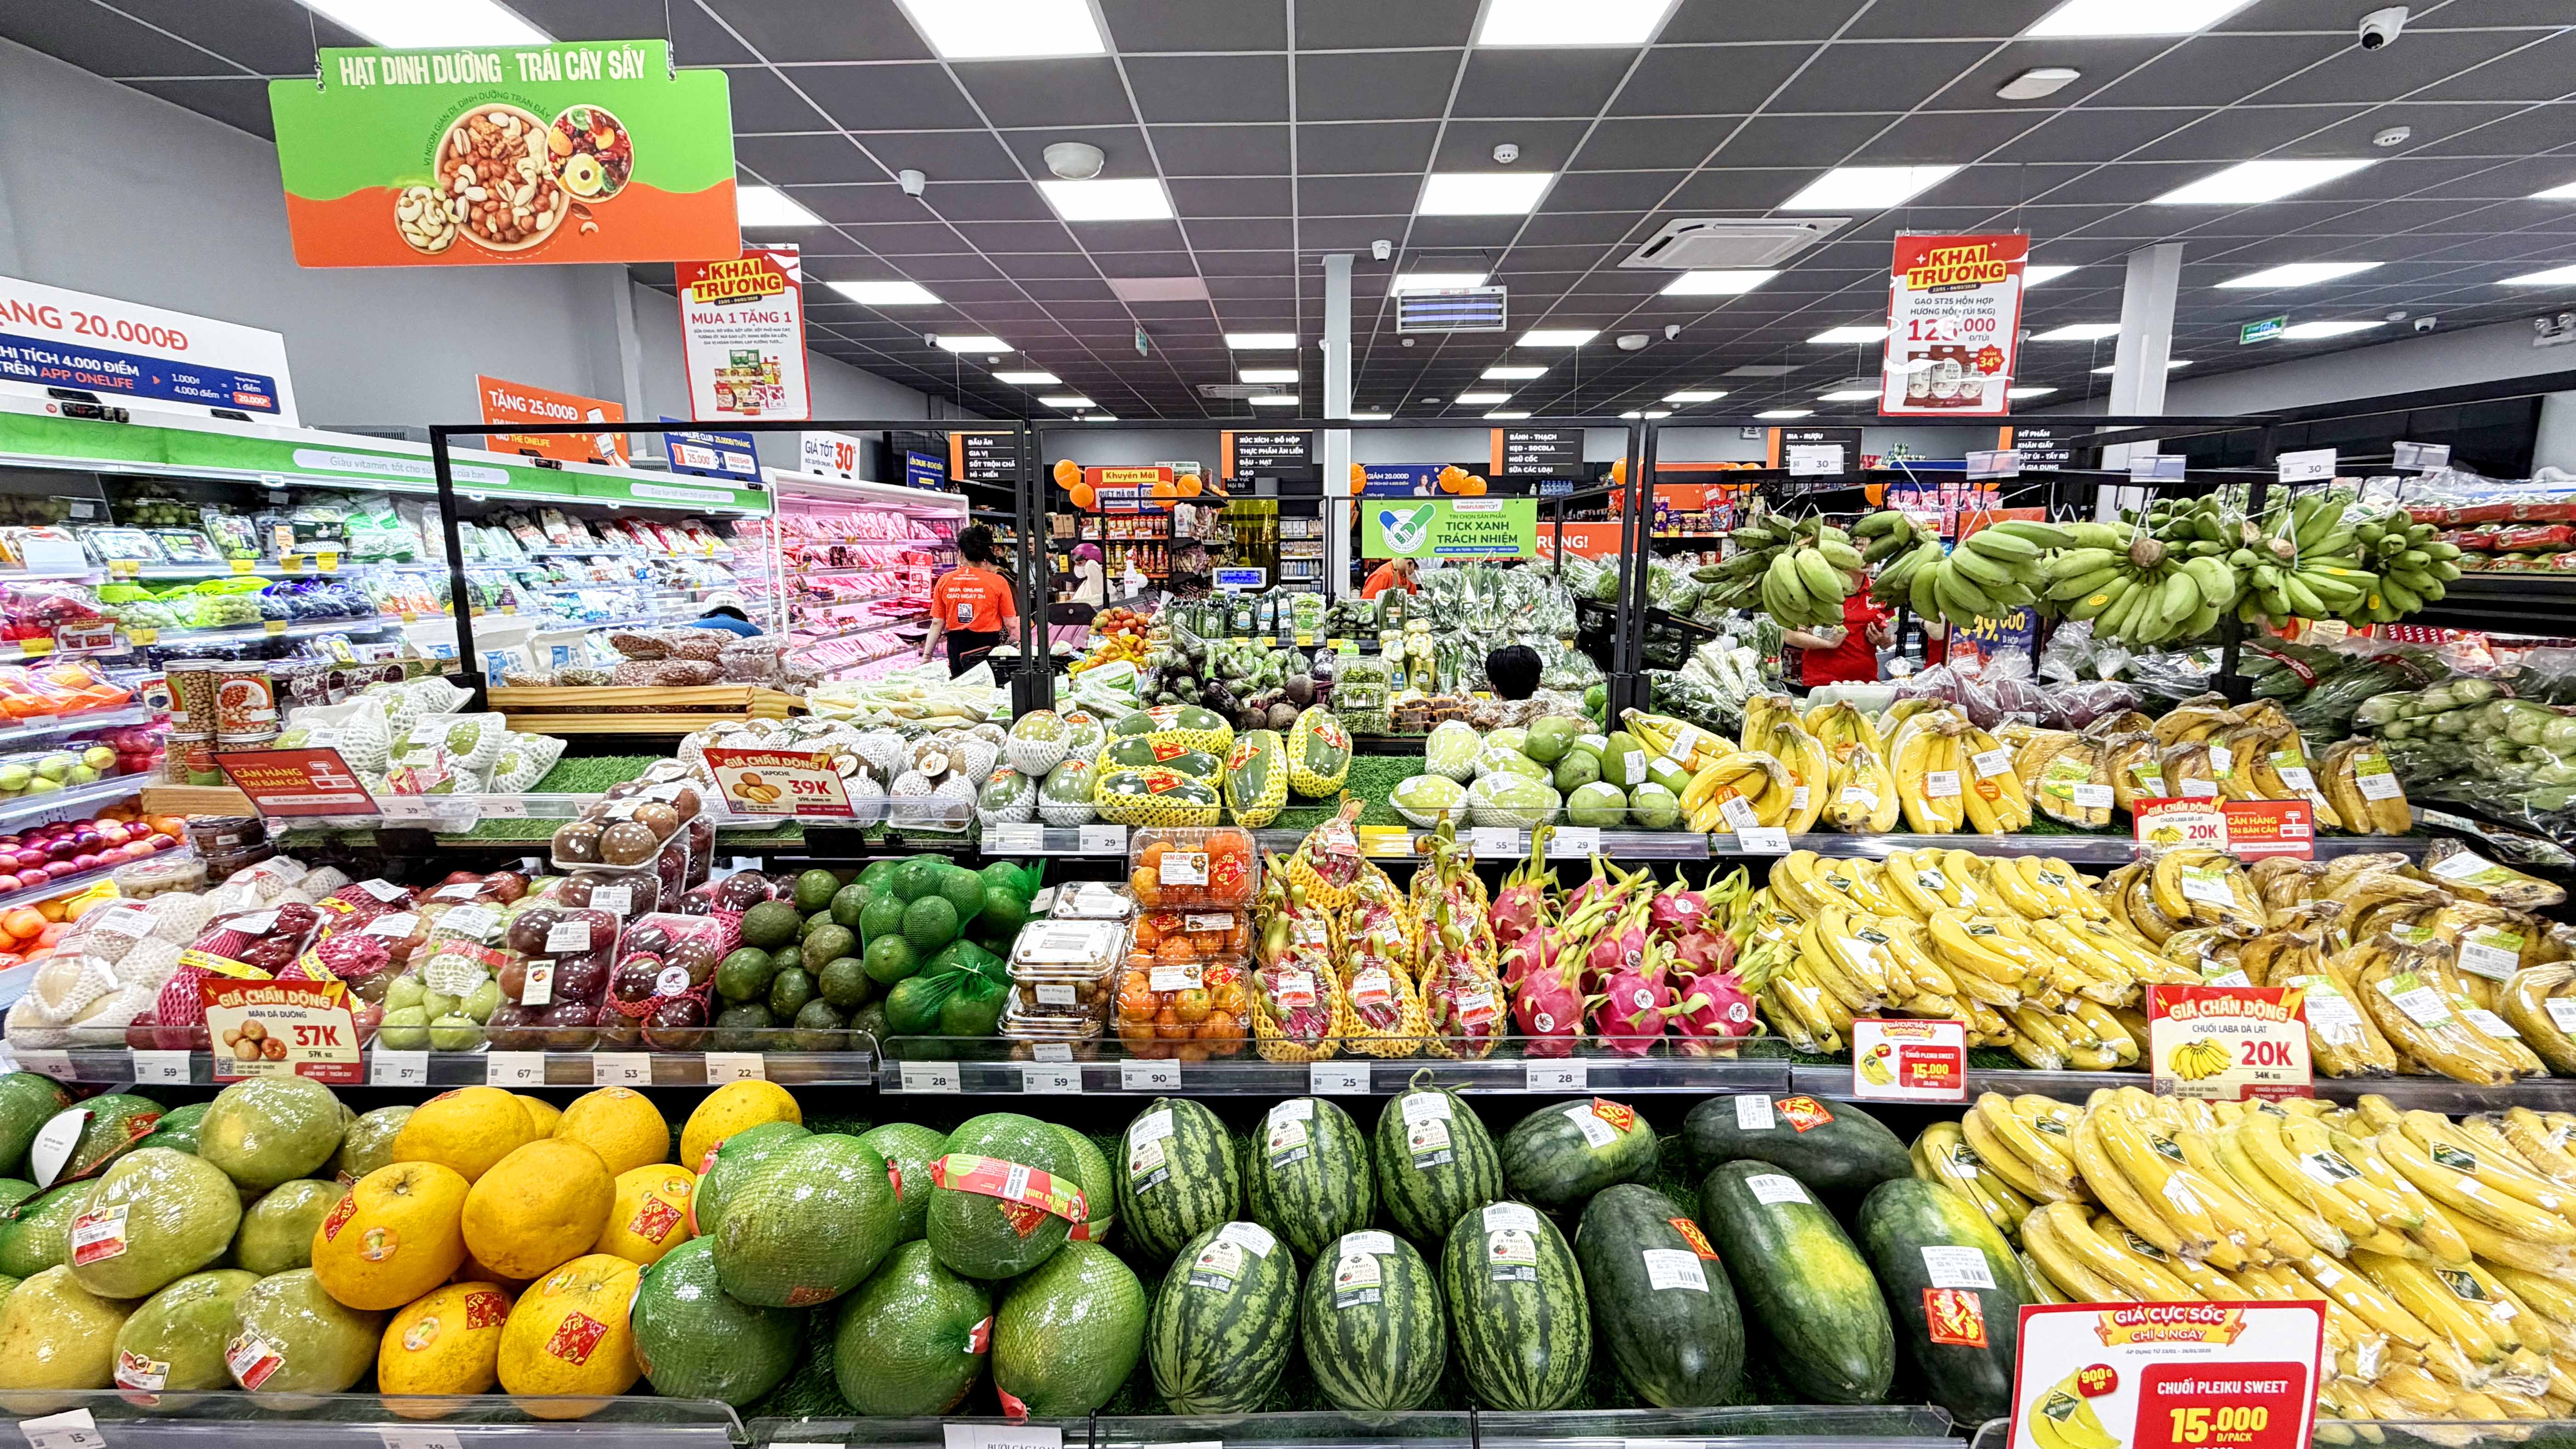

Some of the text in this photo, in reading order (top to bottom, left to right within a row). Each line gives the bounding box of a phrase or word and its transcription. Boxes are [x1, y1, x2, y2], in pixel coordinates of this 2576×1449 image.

[338, 47, 603, 90] HẠT DINH DƯỠNG TRÁI CÂY
[1931, 246, 1986, 268] KHAI
[711, 260, 760, 280] KHAI
[1909, 262, 2005, 286] TRƯƠNG
[693, 275, 782, 298] TRƯƠNG
[1914, 298, 1932, 306] GẠO
[1976, 297, 1994, 306] HỢP
[692, 308, 792, 326] MUA 1 TẶNG 1
[70, 311, 189, 351] 20.000Đ
[1969, 333, 1990, 342] Đ/TÚI
[19, 347, 140, 377] TÍCH 4.000 ĐIỂM
[1979, 355, 2002, 368] 34%
[40, 367, 135, 390] APP ONELIFE
[488, 388, 578, 421] TẶNG 25.000Đ
[1534, 433, 1557, 441] THẠCH
[1803, 432, 1824, 440] RƯỢU
[2030, 429, 2051, 437] PHẨM
[524, 436, 551, 448] ONELIFE
[983, 438, 994, 446] ĂN
[1239, 435, 1301, 445] XÚC XÍCH HỘP
[2038, 440, 2055, 449] GIẤY
[805, 438, 834, 458] GIÁ TỐT
[1509, 444, 1523, 452] KẸO
[981, 450, 988, 458] VỊ
[1524, 454, 1538, 462] CỐC
[392, 462, 421, 474] tốt cho
[969, 459, 1001, 468] SỐT TRỘN
[2308, 464, 2322, 473] 30
[1508, 465, 1554, 474] SỮA CÁC LOẠI
[1106, 472, 1138, 482] Khuyến
[1446, 521, 1509, 531] TICK XANH
[1437, 531, 1518, 546] TRÁCH NHIỆM
[725, 754, 820, 770] GIÁ CHẤN ĐỘNG
[233, 767, 303, 778] CÂN HÀNG
[788, 780, 832, 795] 39K
[2148, 800, 2216, 816] GIÁ CHẤN ĐỘNG
[2228, 815, 2278, 826] CÂN HÀNG
[2188, 824, 2219, 839] 20K
[2261, 825, 2278, 833] CÂN
[1104, 839, 1116, 847] 29
[1495, 841, 1508, 850] 55
[1576, 841, 1589, 850] 29
[1765, 839, 1778, 848] 32
[218, 986, 331, 1010] GIÁ CHẤN ĐỘNG
[2170, 994, 2288, 1022] GIÁ CHẤN ĐỘNG
[1887, 1020, 1929, 1029] GIÁ CỰC SỐC
[2192, 1021, 2239, 1033] CHUỐI LABA
[292, 1025, 342, 1047] 37K
[2241, 1040, 2294, 1067] 20K
[163, 1067, 177, 1077] 59
[400, 1068, 414, 1078] 57
[517, 1069, 531, 1078] 67
[624, 1069, 638, 1079] 53
[737, 1069, 751, 1078] 22
[1912, 1063, 1949, 1079] 15.000
[2254, 1071, 2270, 1079] 34K
[931, 1077, 946, 1087] 28
[1053, 1077, 1068, 1087] 59
[1152, 1073, 1167, 1084] 90
[1342, 1078, 1356, 1087] 25
[1558, 1074, 1573, 1083] 28
[1025, 1187, 1044, 1201] xanh
[1045, 1193, 1054, 1205] da
[645, 1199, 664, 1216] Tết
[1055, 1195, 1068, 1213] Bưởi
[466, 1293, 485, 1311] Tết
[2114, 1303, 2226, 1324] GIÁ CỰC SỐC
[562, 1318, 585, 1335] Tết
[2131, 1327, 2206, 1341] CHỈ 4 NGÀY
[2093, 1381, 2105, 1391] UP
[2157, 1377, 2288, 1395] CHUỐI PLEIKU SWEET
[2170, 1406, 2268, 1443] 15.000
[69, 1432, 86, 1443] 15
[2216, 1431, 2253, 1443] Đ/PACK
